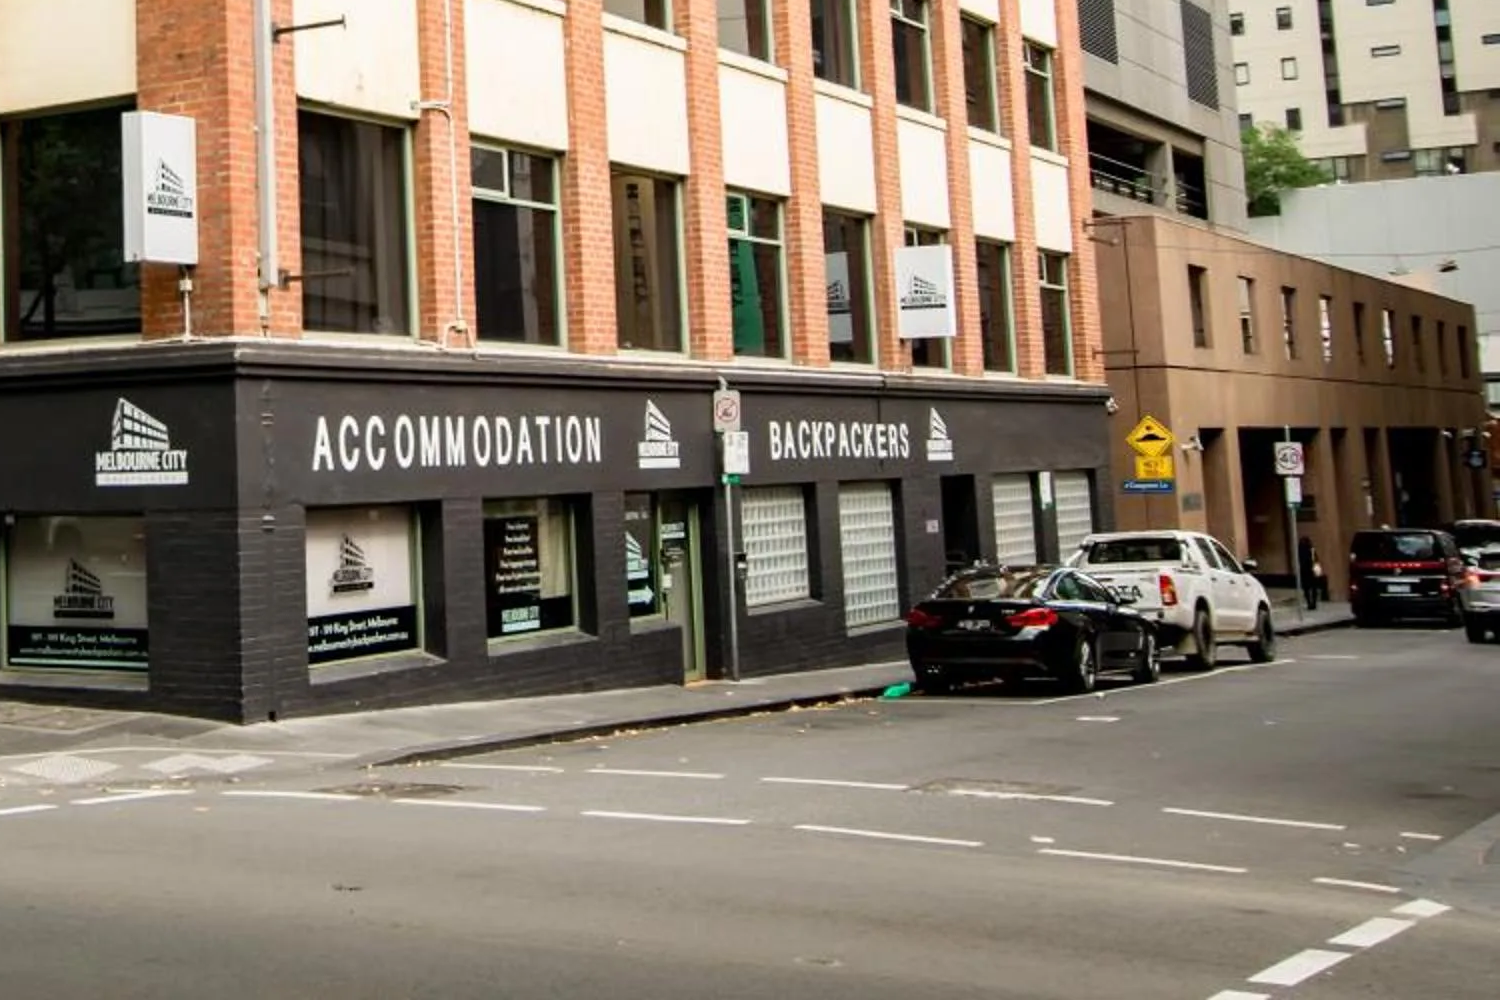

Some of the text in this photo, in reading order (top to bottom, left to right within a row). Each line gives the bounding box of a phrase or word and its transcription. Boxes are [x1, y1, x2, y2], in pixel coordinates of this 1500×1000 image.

[96, 449, 187, 471] MELBOURNE CITY
[312, 414, 601, 471] ACCOMMODATION
[769, 420, 910, 460] BACKPACKERS
